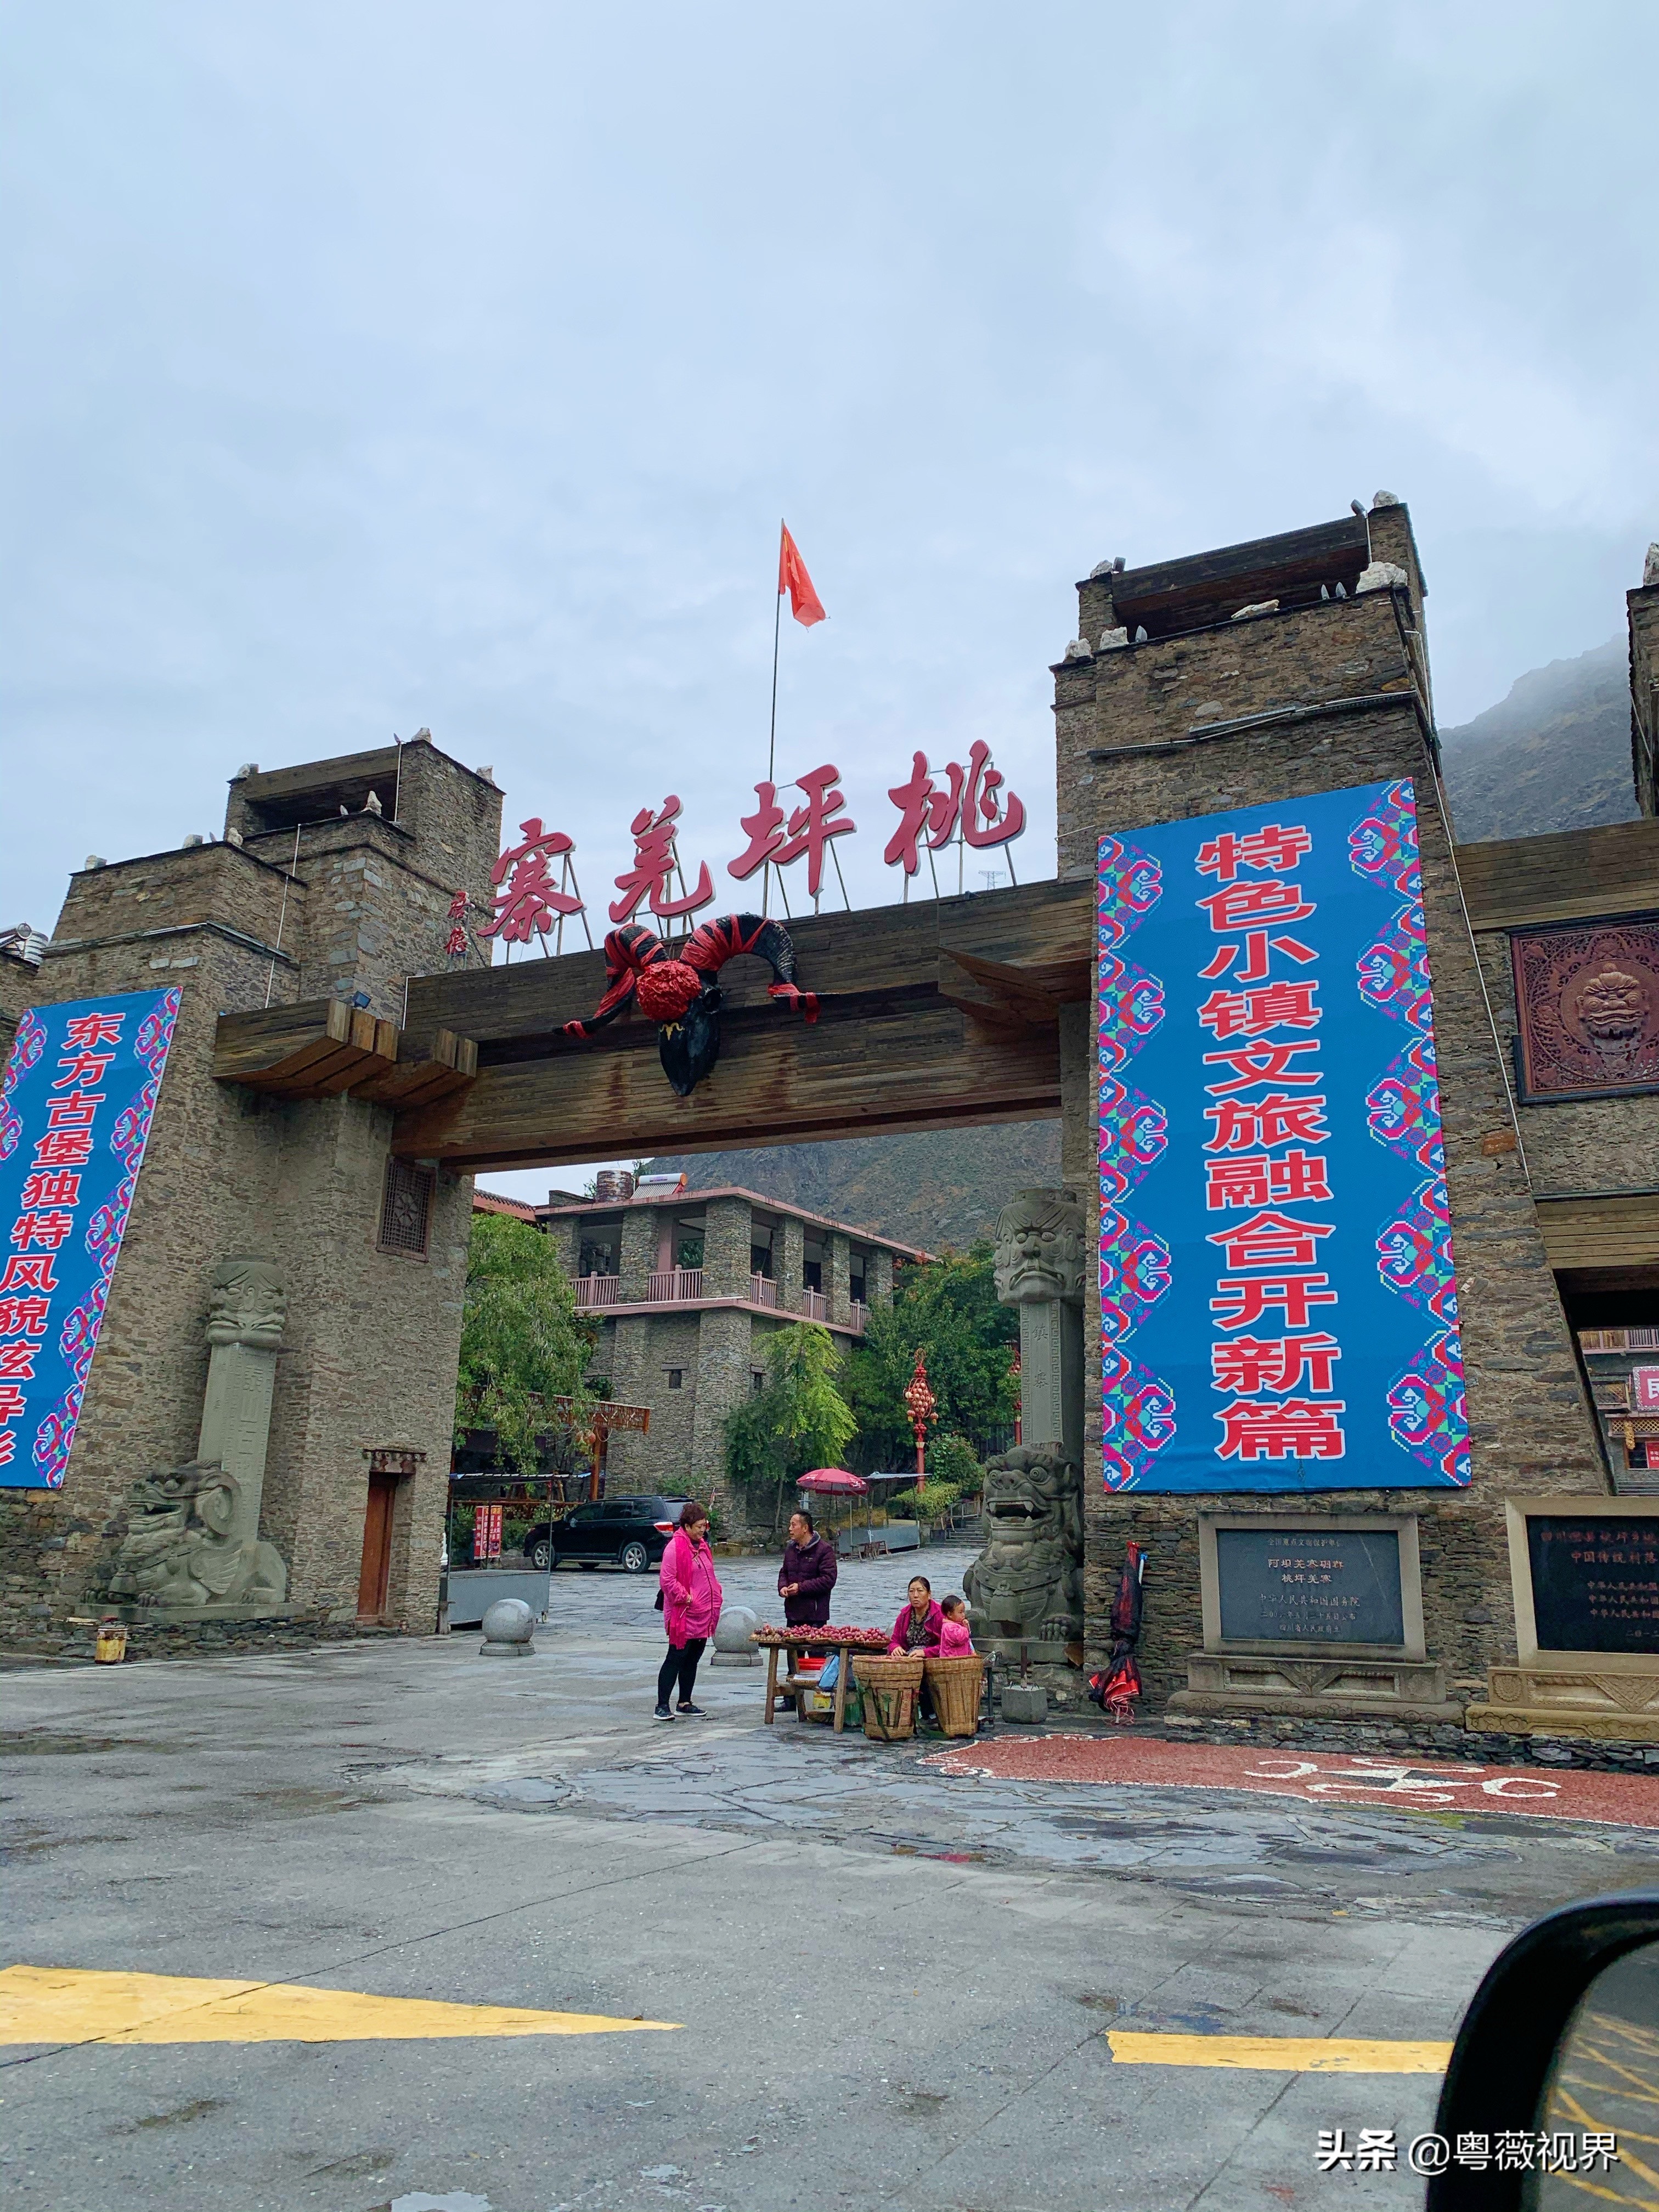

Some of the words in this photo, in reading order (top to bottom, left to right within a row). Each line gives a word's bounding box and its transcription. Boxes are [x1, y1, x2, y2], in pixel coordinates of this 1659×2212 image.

[1195, 823, 1345, 1460] 特色小镇文旅融合开新篇
[1281, 1573, 1333, 1584] 桃坪羌寨
[1259, 1593, 1361, 1607] 中华人民共和国国务院
